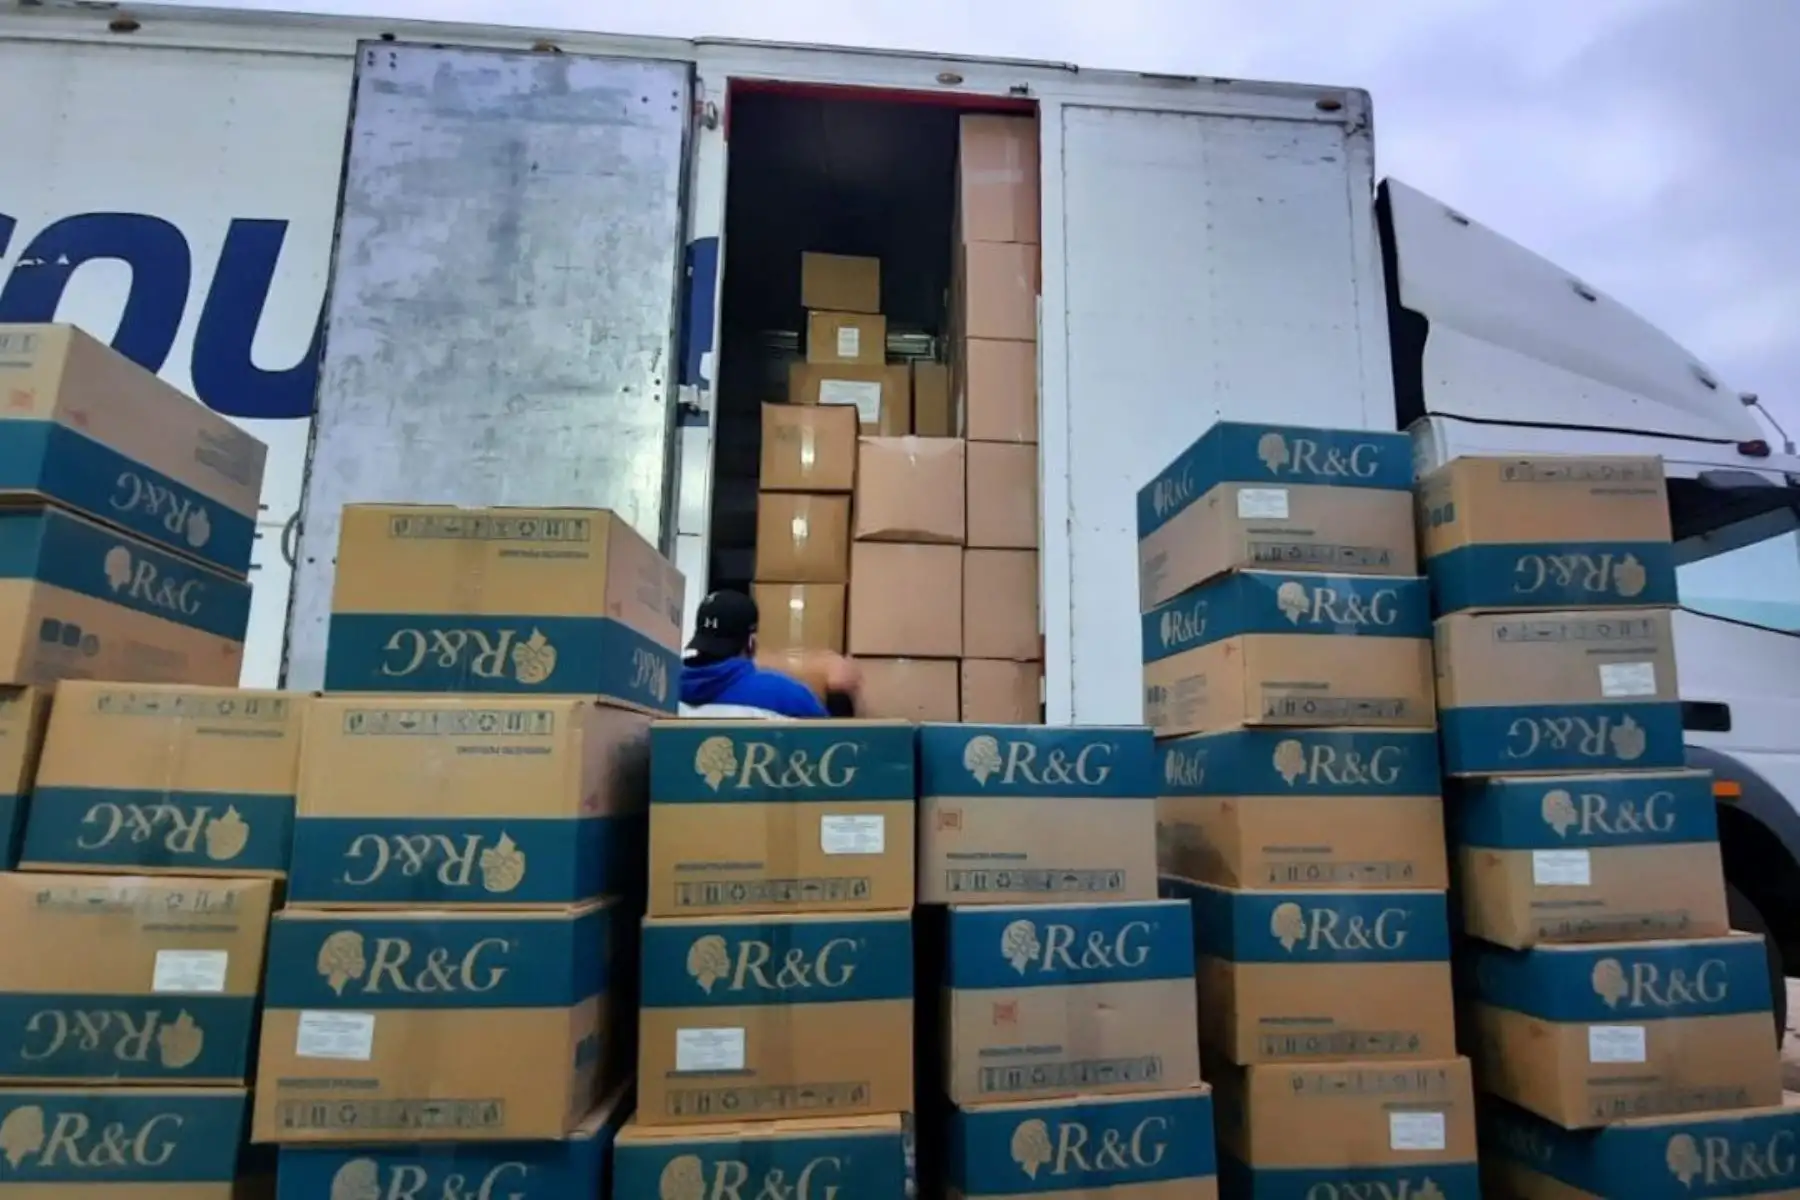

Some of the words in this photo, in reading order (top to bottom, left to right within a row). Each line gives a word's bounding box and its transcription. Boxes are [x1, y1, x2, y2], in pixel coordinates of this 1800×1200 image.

[0, 212, 327, 419] ou
[1288, 438, 1379, 478] R&G
[110, 472, 191, 533] R&G
[130, 559, 204, 615] R&G
[1514, 554, 1614, 594] R&G
[1170, 601, 1207, 641] R&G
[1309, 587, 1398, 626] R&G
[382, 628, 516, 678] R&G
[1507, 716, 1611, 759] R&G
[735, 741, 859, 789] R&G
[1000, 741, 1112, 785] R&G
[1306, 745, 1402, 785] R&G
[77, 802, 212, 853] R&G
[1578, 791, 1677, 835] R&G
[344, 833, 485, 885] R&G
[1039, 921, 1151, 973] R&G
[1306, 908, 1408, 951] R&G
[362, 937, 509, 993] R&G
[728, 938, 858, 991] R&G
[1629, 959, 1729, 1008] R&G
[20, 1009, 162, 1061] R&G
[37, 1112, 184, 1167] R&G
[1050, 1116, 1168, 1176] R&G
[1703, 1130, 1796, 1184] R&G
[385, 1161, 528, 1200] R&G
[709, 1156, 842, 1200] R&G
